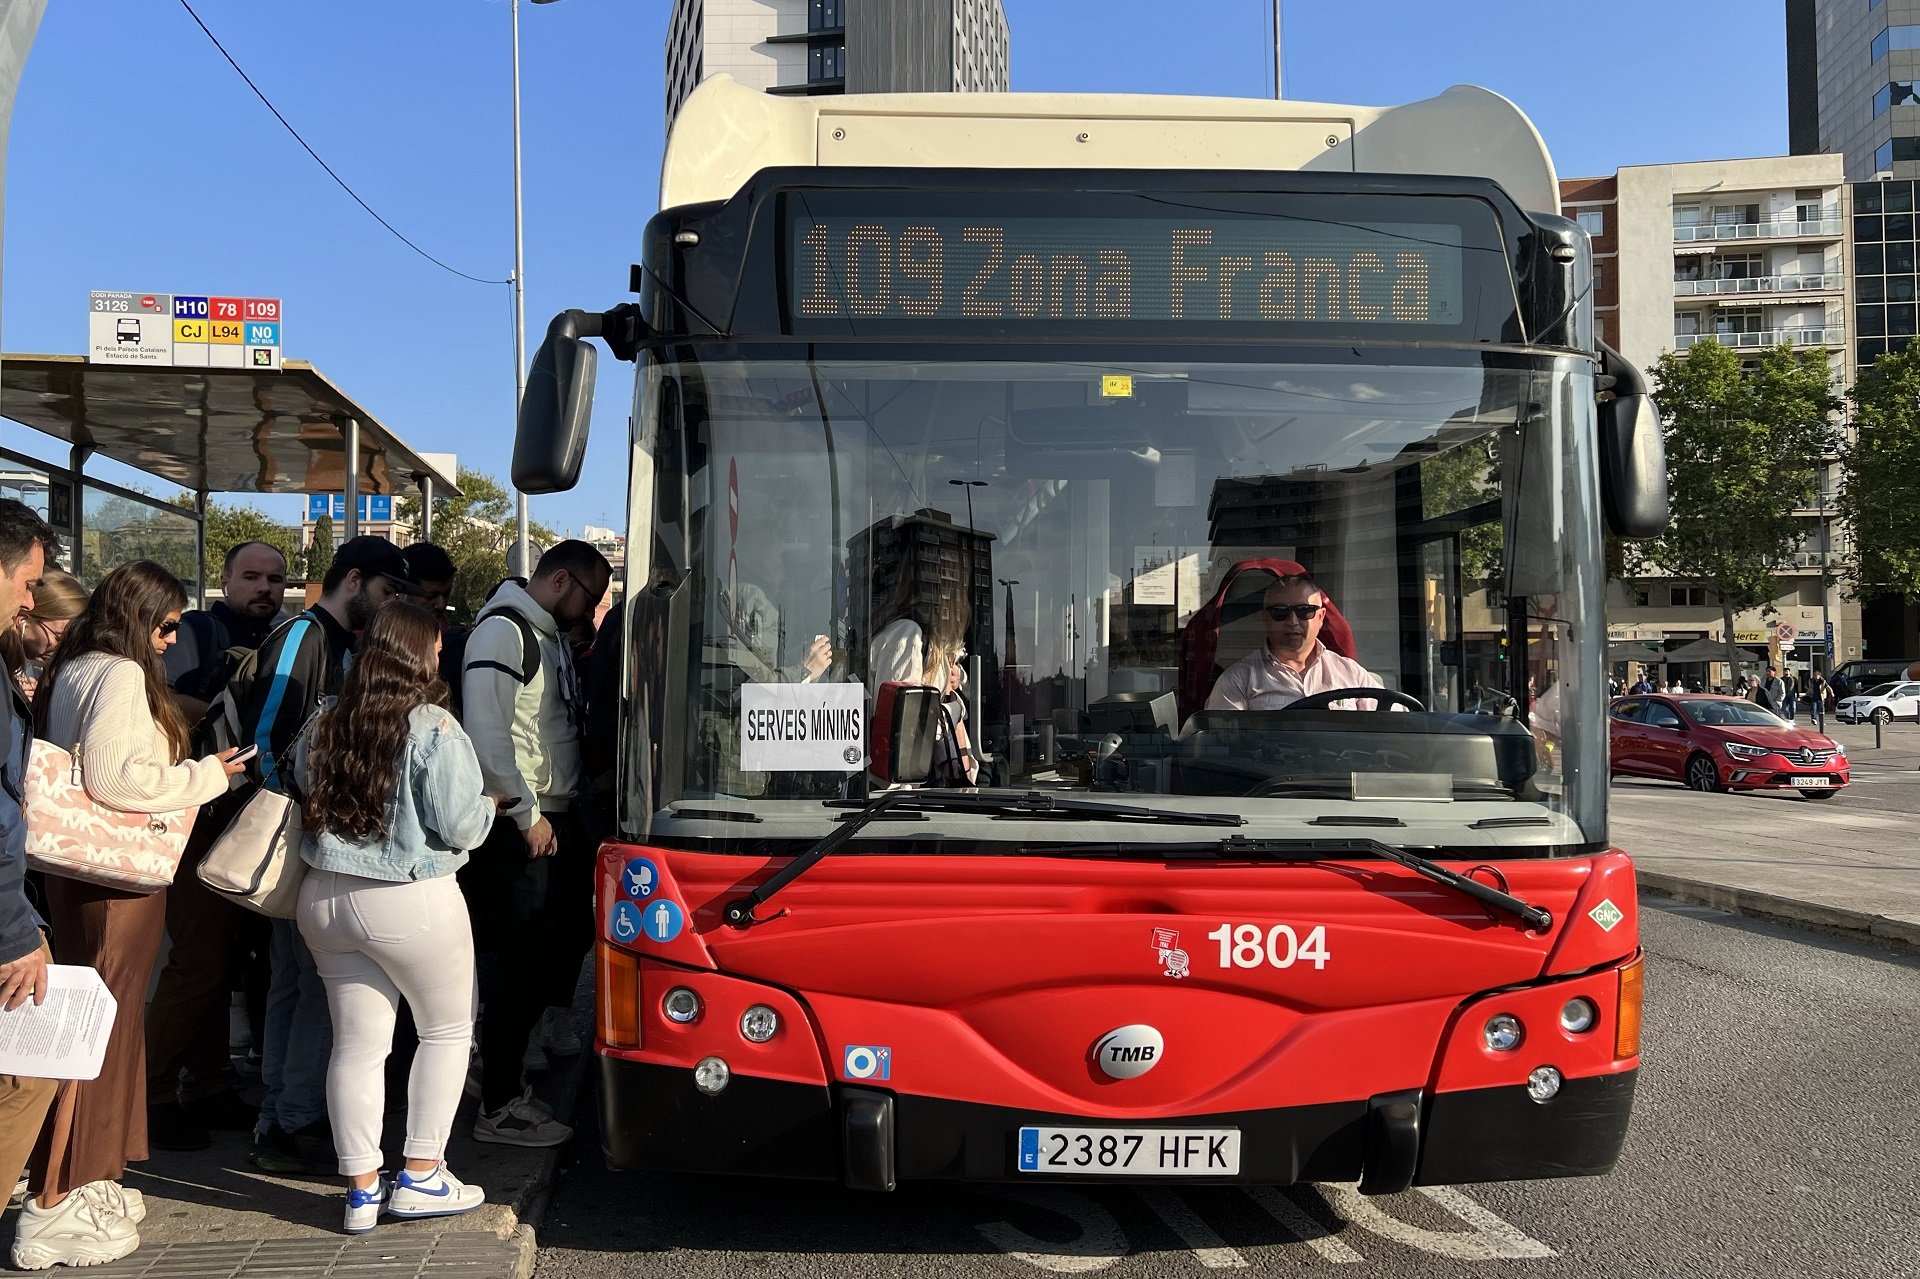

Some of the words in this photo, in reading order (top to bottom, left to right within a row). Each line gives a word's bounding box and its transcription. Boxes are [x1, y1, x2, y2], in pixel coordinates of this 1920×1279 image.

[802, 224, 944, 316] 109
[963, 226, 1132, 318] Zona
[1170, 228, 1429, 320] Franca
[95, 299, 129, 312] 3126
[175, 300, 208, 315] H10
[217, 302, 237, 317] 78
[248, 302, 277, 317] 109
[181, 325, 202, 338] CJ
[212, 325, 240, 338] L94
[1733, 633, 1759, 641] Hertz
[747, 708, 807, 741] SERVEIS
[811, 701, 860, 741] MÍNIMS
[1796, 778, 1814, 786] 3249
[1595, 908, 1618, 922] GNC
[1208, 923, 1331, 970] 1804
[1109, 1045, 1156, 1063] TMB
[1025, 1153, 1034, 1163] E
[1048, 1133, 1144, 1167] 2387
[1159, 1135, 1229, 1168] HFK
